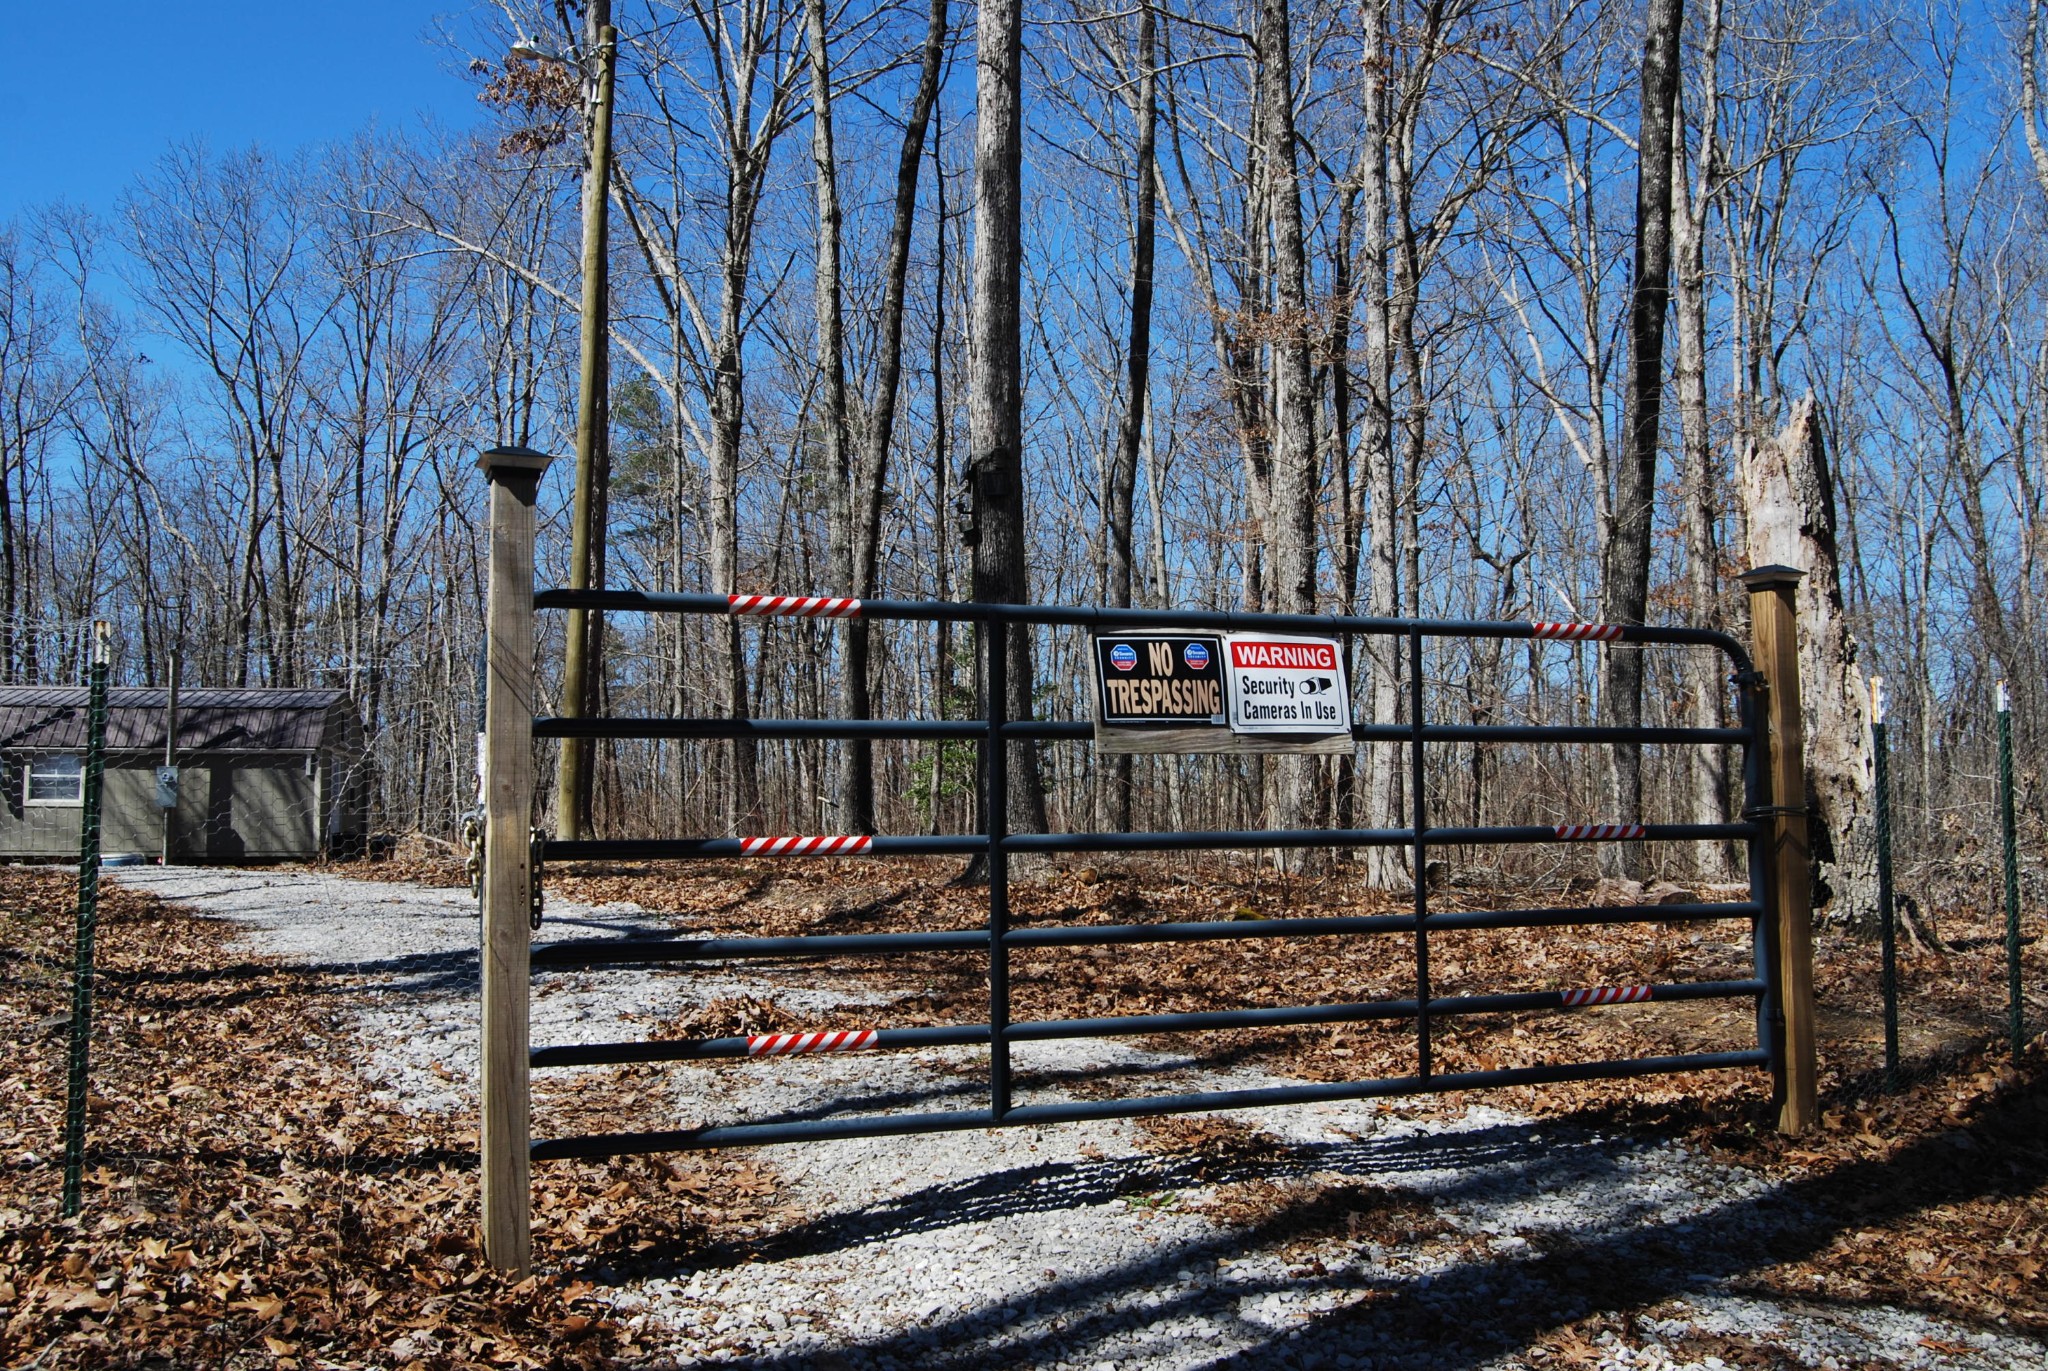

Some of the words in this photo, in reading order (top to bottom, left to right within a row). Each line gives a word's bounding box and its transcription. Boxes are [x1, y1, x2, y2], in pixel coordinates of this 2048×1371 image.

[1147, 641, 1174, 677] NO
[1236, 645, 1332, 667] WARNING
[1106, 679, 1221, 714] TRESPASSING
[1242, 675, 1295, 699] Security
[1243, 700, 1297, 720] Cameras
[1300, 701, 1312, 719] In
[1315, 701, 1336, 720] Use
